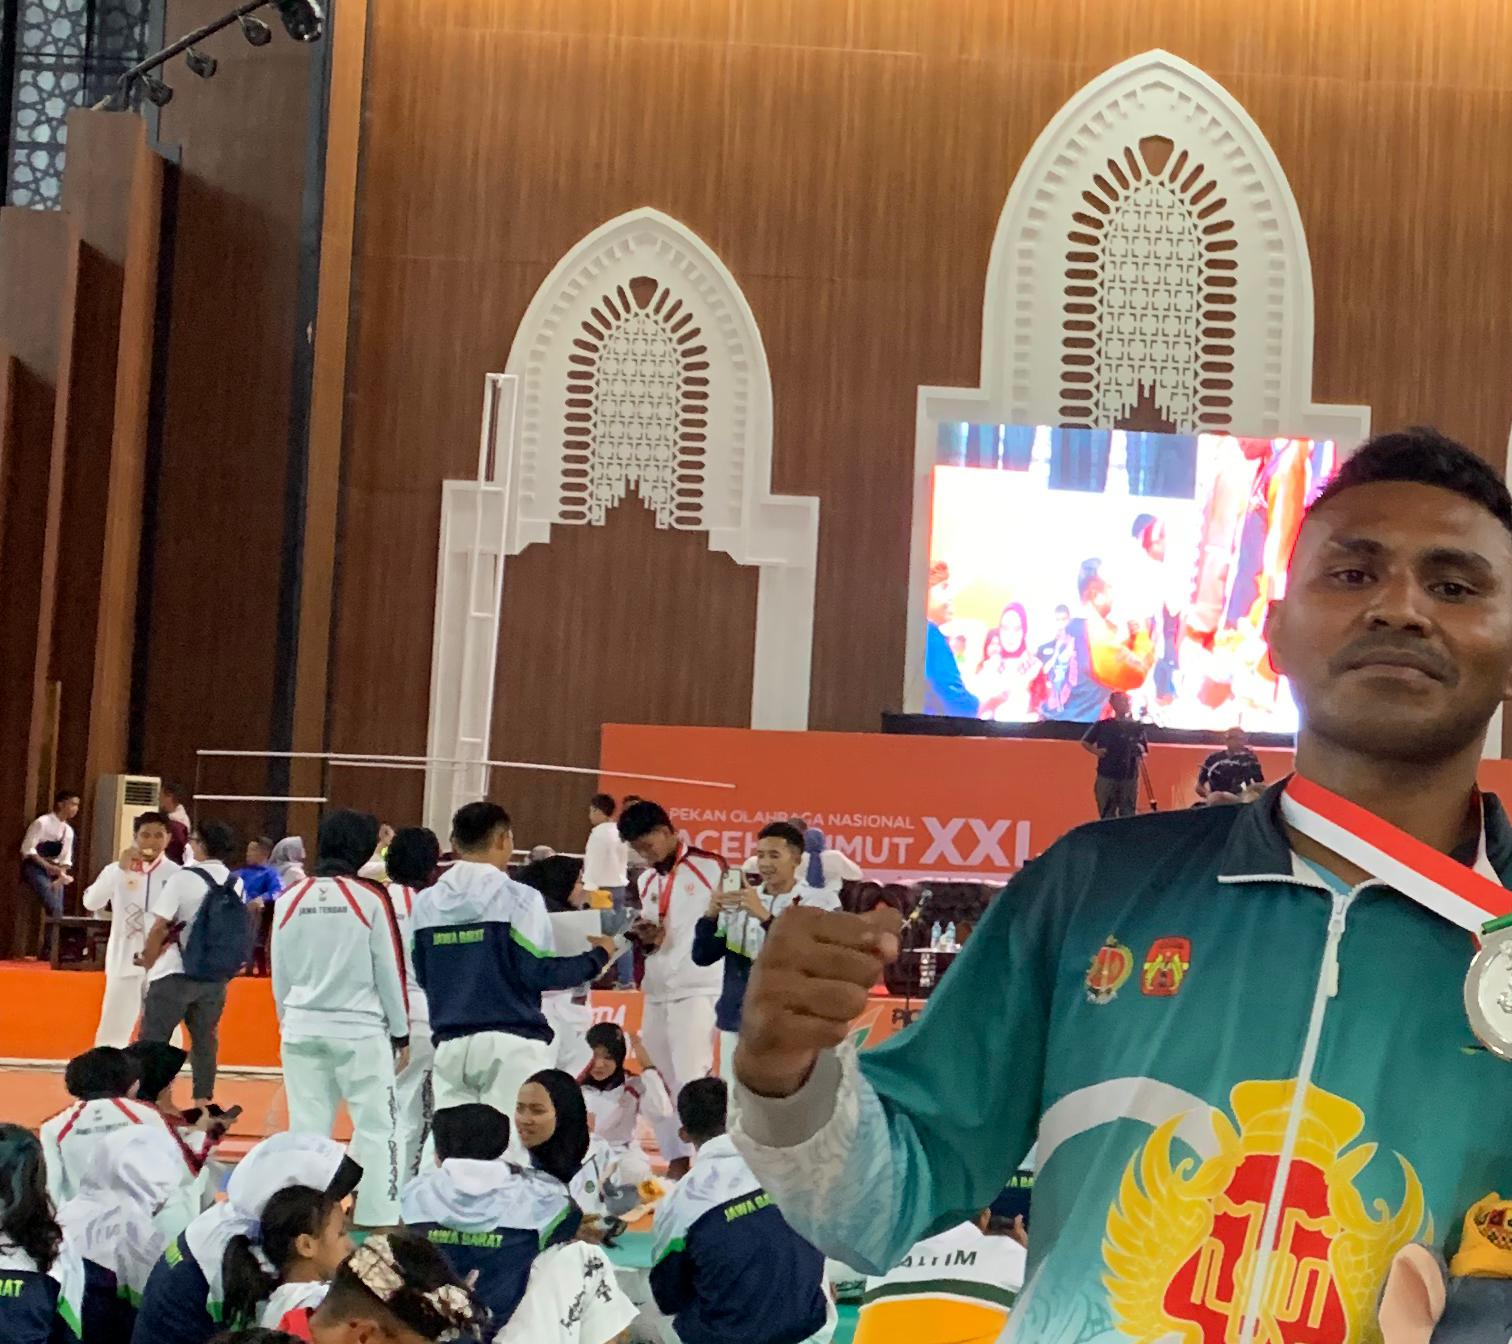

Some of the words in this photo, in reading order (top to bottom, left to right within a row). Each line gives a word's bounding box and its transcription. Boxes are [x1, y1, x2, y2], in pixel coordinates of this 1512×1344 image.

[669, 807, 726, 822] PEKAN
[828, 813, 915, 829] NASIONAL
[919, 817, 1031, 867] XXI
[900, 1250, 977, 1267] ALTIM
